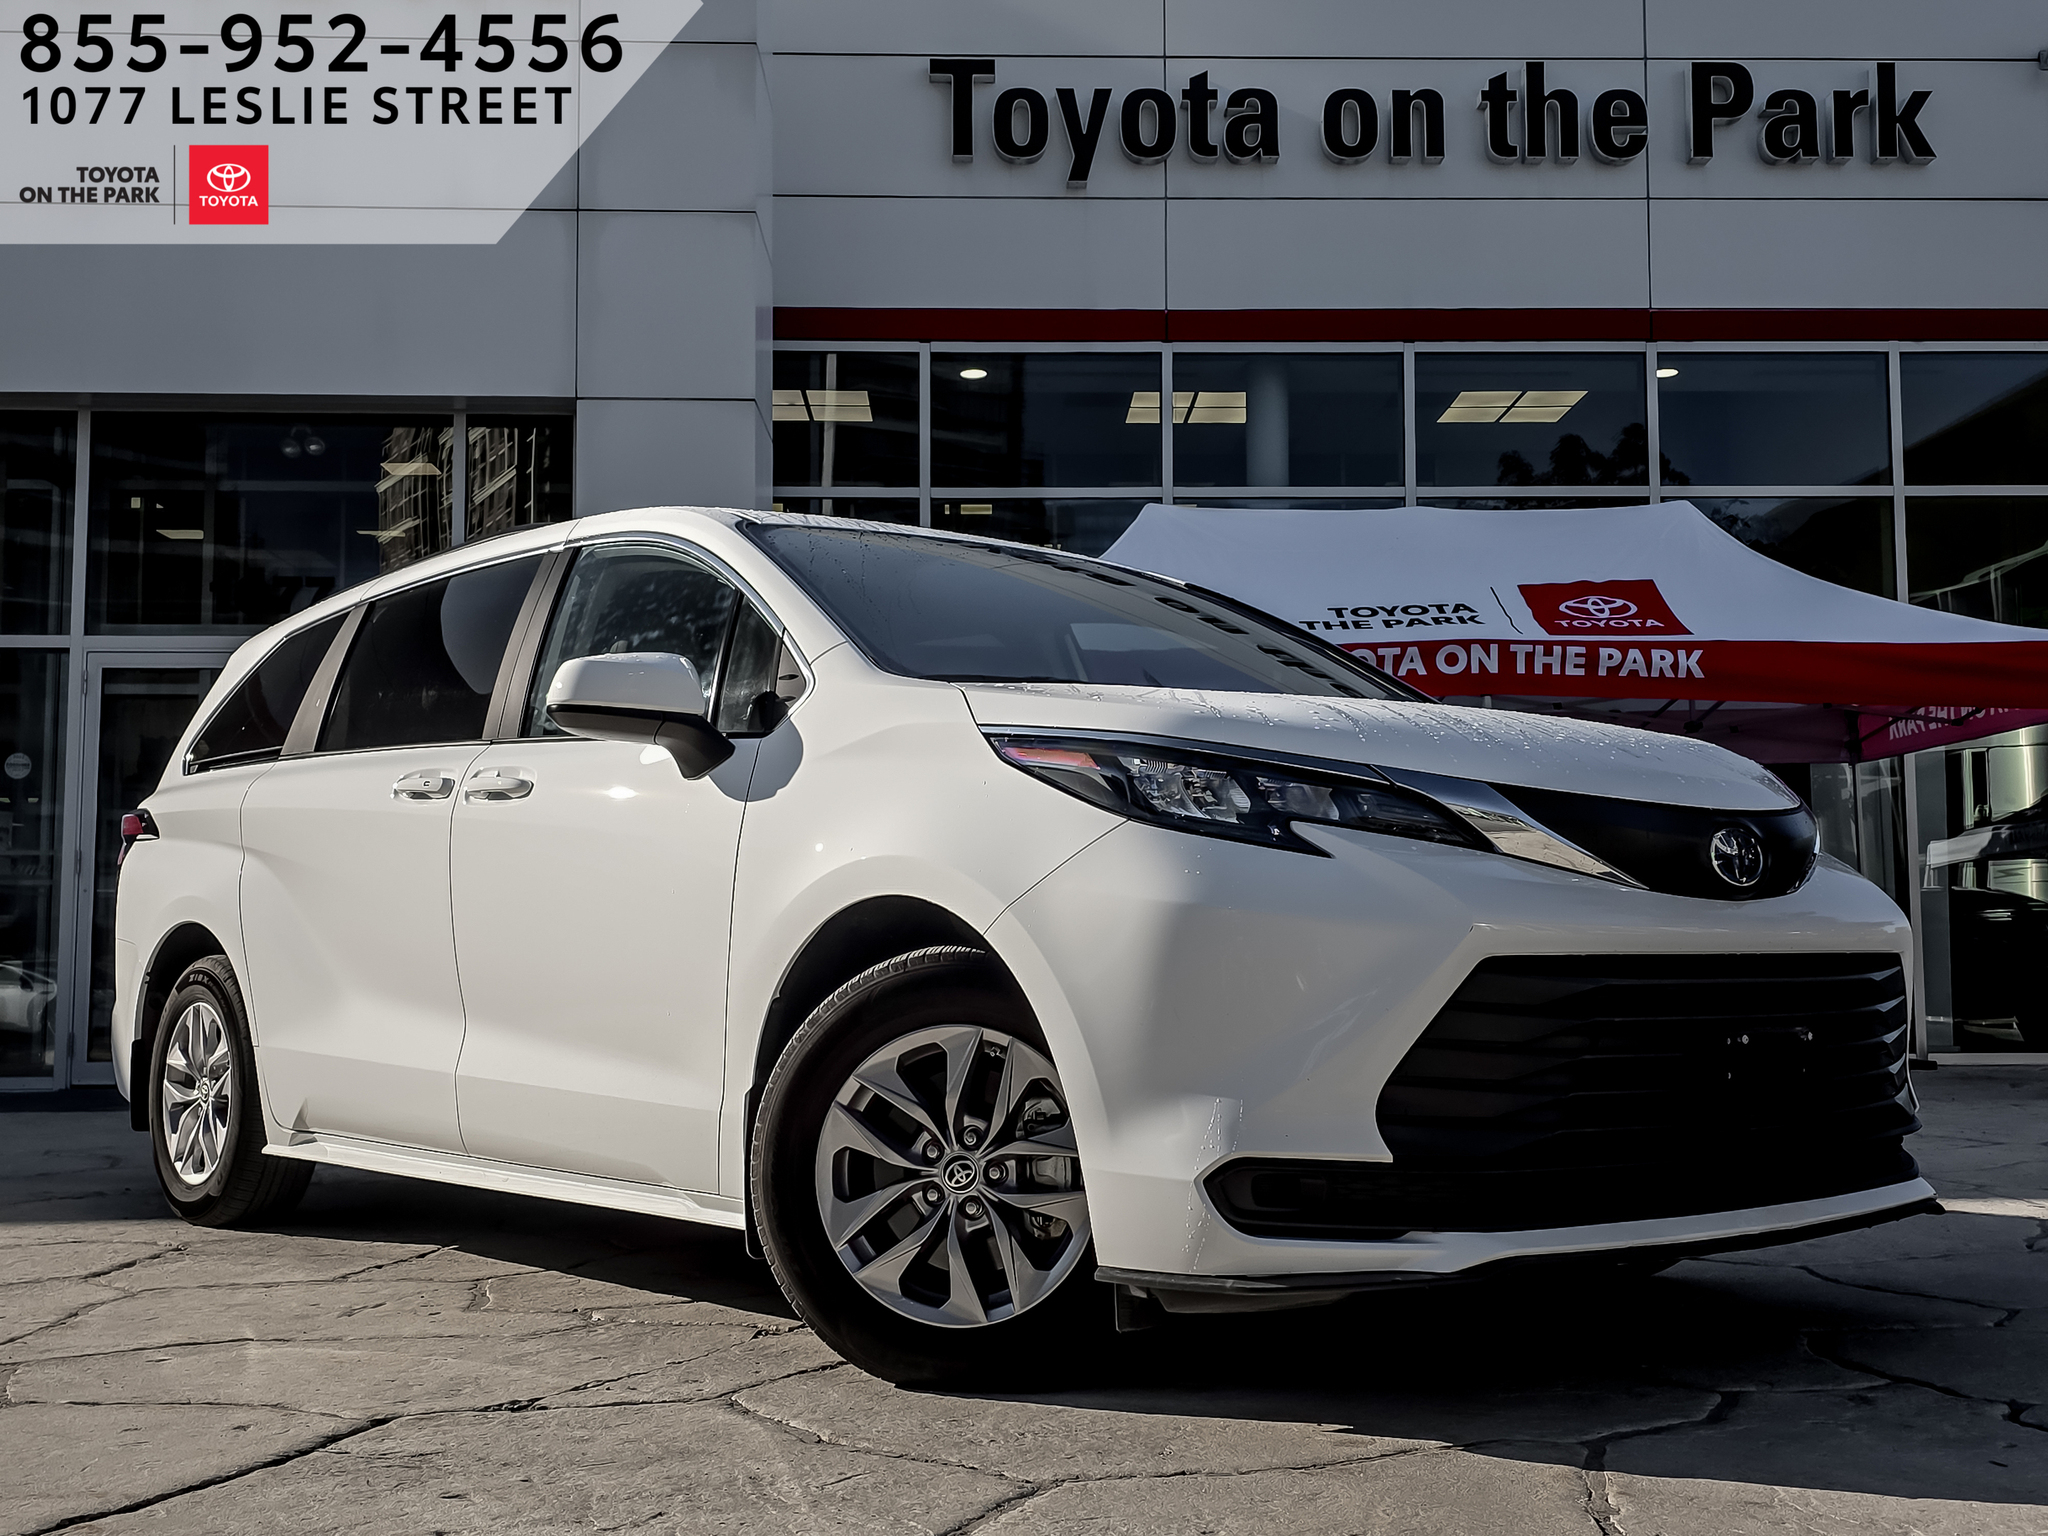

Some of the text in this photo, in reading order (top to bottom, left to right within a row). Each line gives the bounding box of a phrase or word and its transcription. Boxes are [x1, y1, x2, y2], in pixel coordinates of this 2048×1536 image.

[928, 58, 1938, 188] Toyota on the Park
[1327, 603, 1479, 618] TOYOTA
[1299, 615, 1486, 630] THE PARK
[1554, 619, 1665, 628] TOYOTA
[1435, 643, 1499, 675] ON
[1510, 644, 1586, 676] THE
[1598, 646, 1705, 679] PARK
